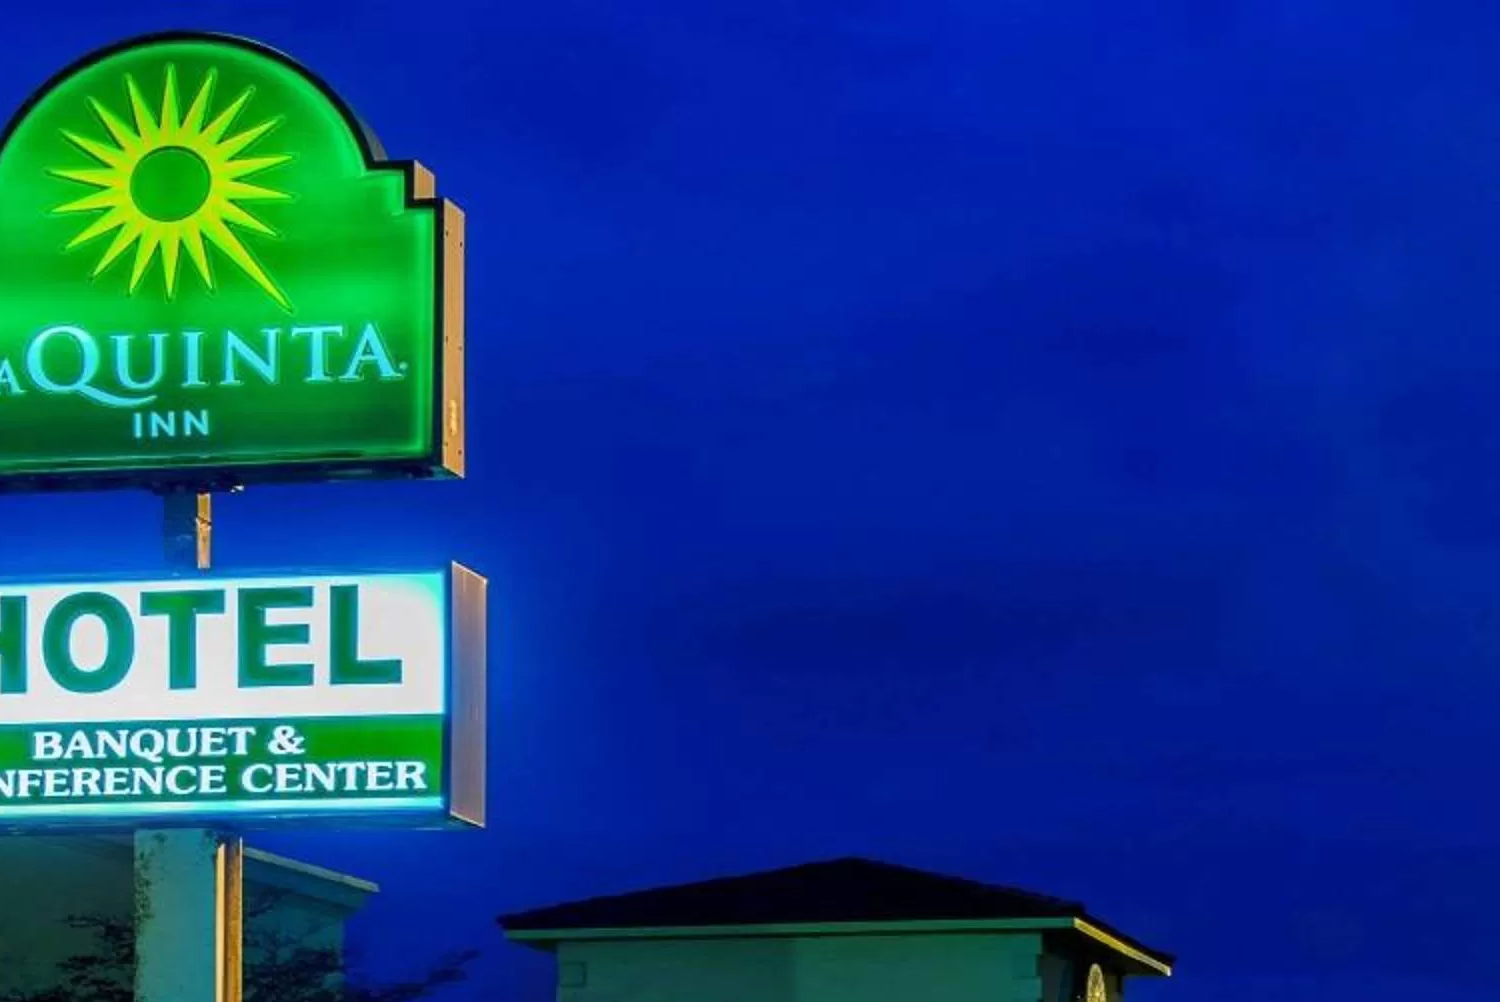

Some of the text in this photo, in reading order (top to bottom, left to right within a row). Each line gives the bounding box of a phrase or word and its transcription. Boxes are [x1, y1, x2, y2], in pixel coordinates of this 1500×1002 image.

[25, 322, 403, 407] QUINTA
[132, 410, 209, 438] INN
[32, 725, 306, 763] BANQUET &
[241, 760, 427, 794] CENTER
